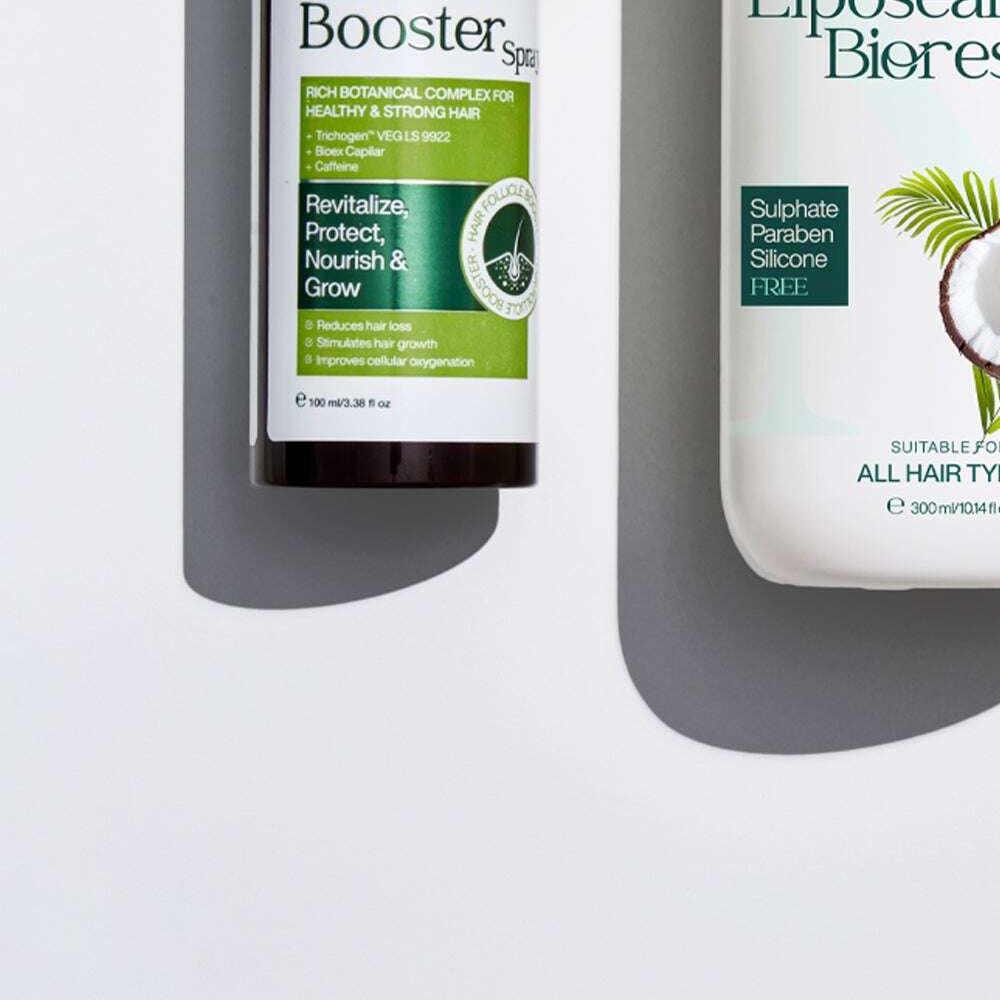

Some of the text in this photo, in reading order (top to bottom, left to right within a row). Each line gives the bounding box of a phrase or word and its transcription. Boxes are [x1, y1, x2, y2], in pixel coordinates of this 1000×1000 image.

[299, 2, 506, 52] Booster
[306, 86, 514, 101] RICH BOTANICAL COMPLEX FOR
[306, 105, 480, 119] HEALTHY & STRONG HAIR
[377, 131, 402, 142] VEG
[405, 131, 420, 142] LS
[422, 131, 451, 142] 9922
[315, 146, 344, 156] Bioex
[345, 146, 385, 158] Capilar
[315, 162, 358, 172] Caffeine
[305, 194, 409, 219] Revitalize,
[750, 198, 839, 221] Sulphate
[305, 222, 385, 245] Protect,
[468, 211, 485, 241] HAIR
[750, 223, 834, 243] Paraben
[305, 251, 408, 270] Nourish &
[750, 248, 828, 268] Silicone
[305, 278, 361, 298] Grow
[467, 254, 505, 311] BOOSTER
[750, 277, 808, 296] FREE
[316, 320, 412, 332] Reduces hair loss
[316, 337, 438, 352] Stimulates hair growth
[316, 356, 474, 369] Improves cellular oxygenation
[309, 398, 326, 407] 100
[328, 398, 366, 407] ml/3.38
[369, 399, 375, 407] fl
[891, 441, 969, 453] SUITABLE
[857, 464, 900, 482] ALL
[906, 464, 962, 482] HAIR
[911, 502, 937, 515] 300
[989, 502, 997, 514] fl
